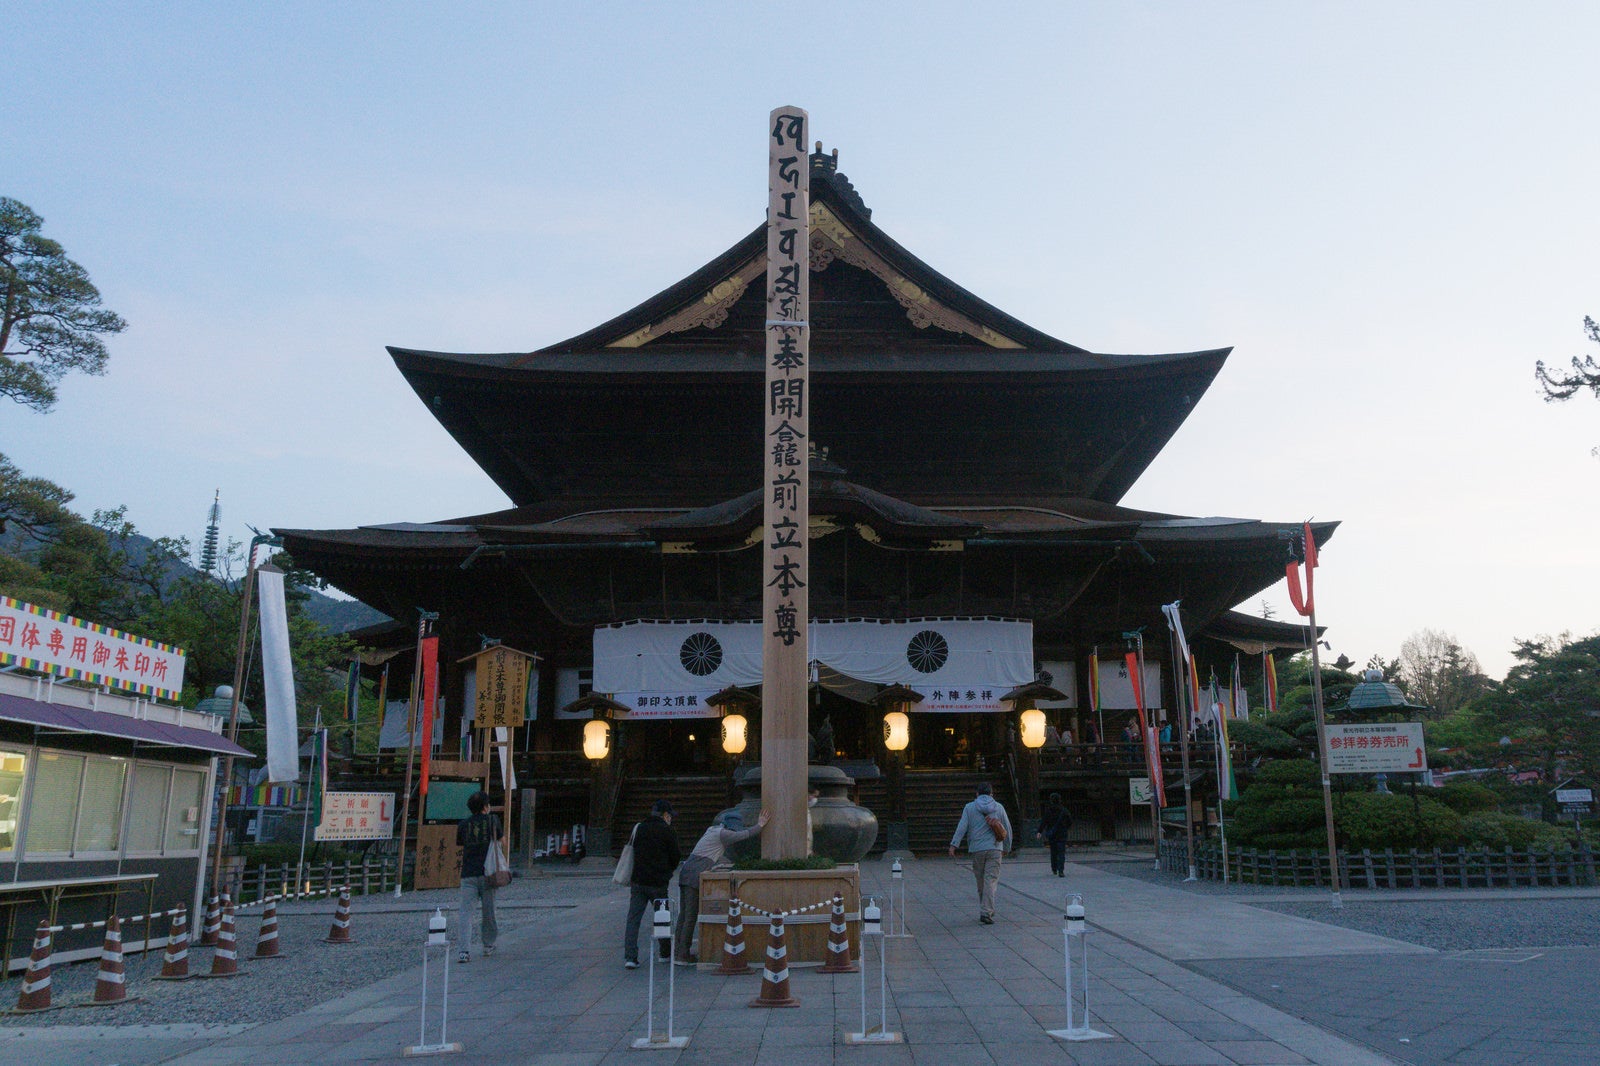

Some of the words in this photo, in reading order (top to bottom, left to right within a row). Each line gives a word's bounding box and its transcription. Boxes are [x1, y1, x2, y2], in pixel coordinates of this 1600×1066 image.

[0, 615, 169, 682] 団体専用御朱印所
[637, 696, 698, 708] 御印文頂戴
[932, 690, 993, 701] 外陣参拝
[1330, 735, 1409, 749] 参拝券券売所
